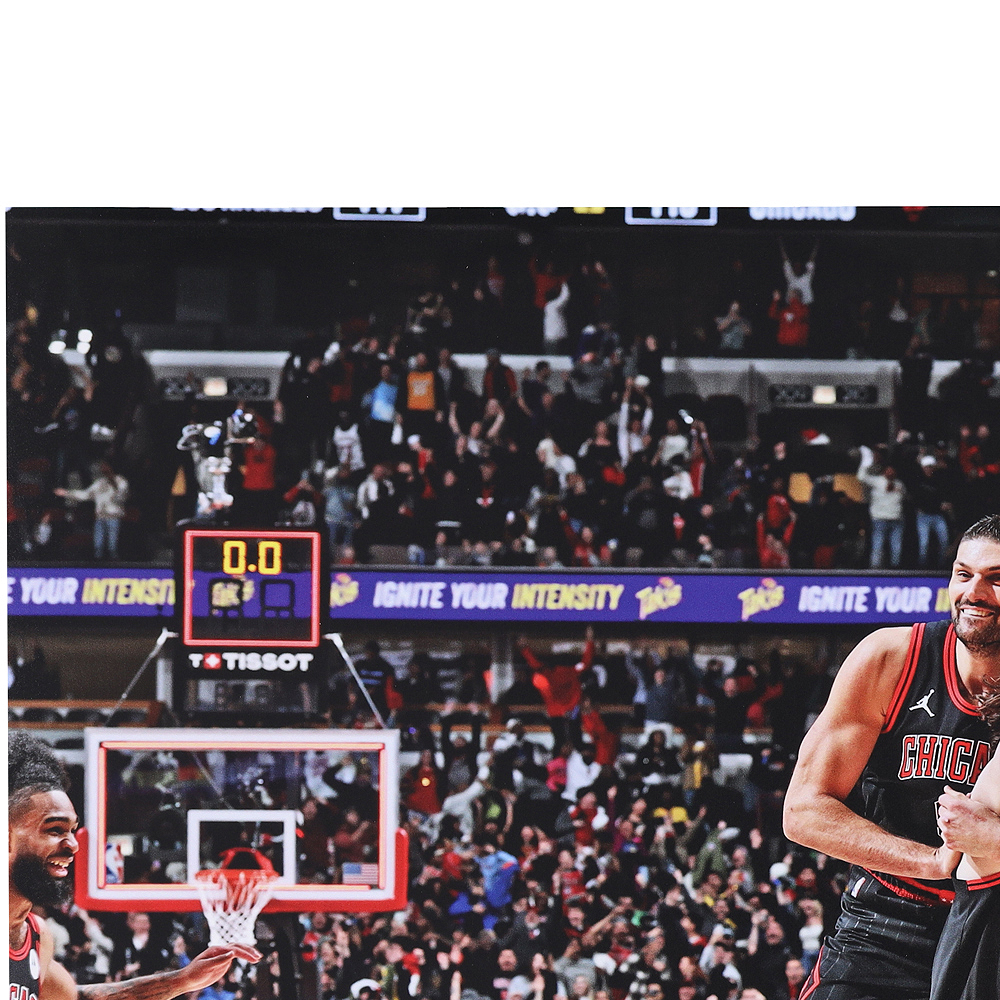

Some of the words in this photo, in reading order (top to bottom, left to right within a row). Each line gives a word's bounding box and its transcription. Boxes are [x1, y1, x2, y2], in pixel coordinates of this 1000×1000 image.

[223, 540, 282, 575] 0.0
[20, 577, 78, 605] YOUR
[372, 580, 447, 608] IGNITE
[450, 581, 509, 608] YOUR
[511, 583, 625, 610] INTENSITY
[798, 584, 873, 613] IGNITE
[875, 585, 932, 613] YOUR
[222, 652, 314, 672] TISSOT
